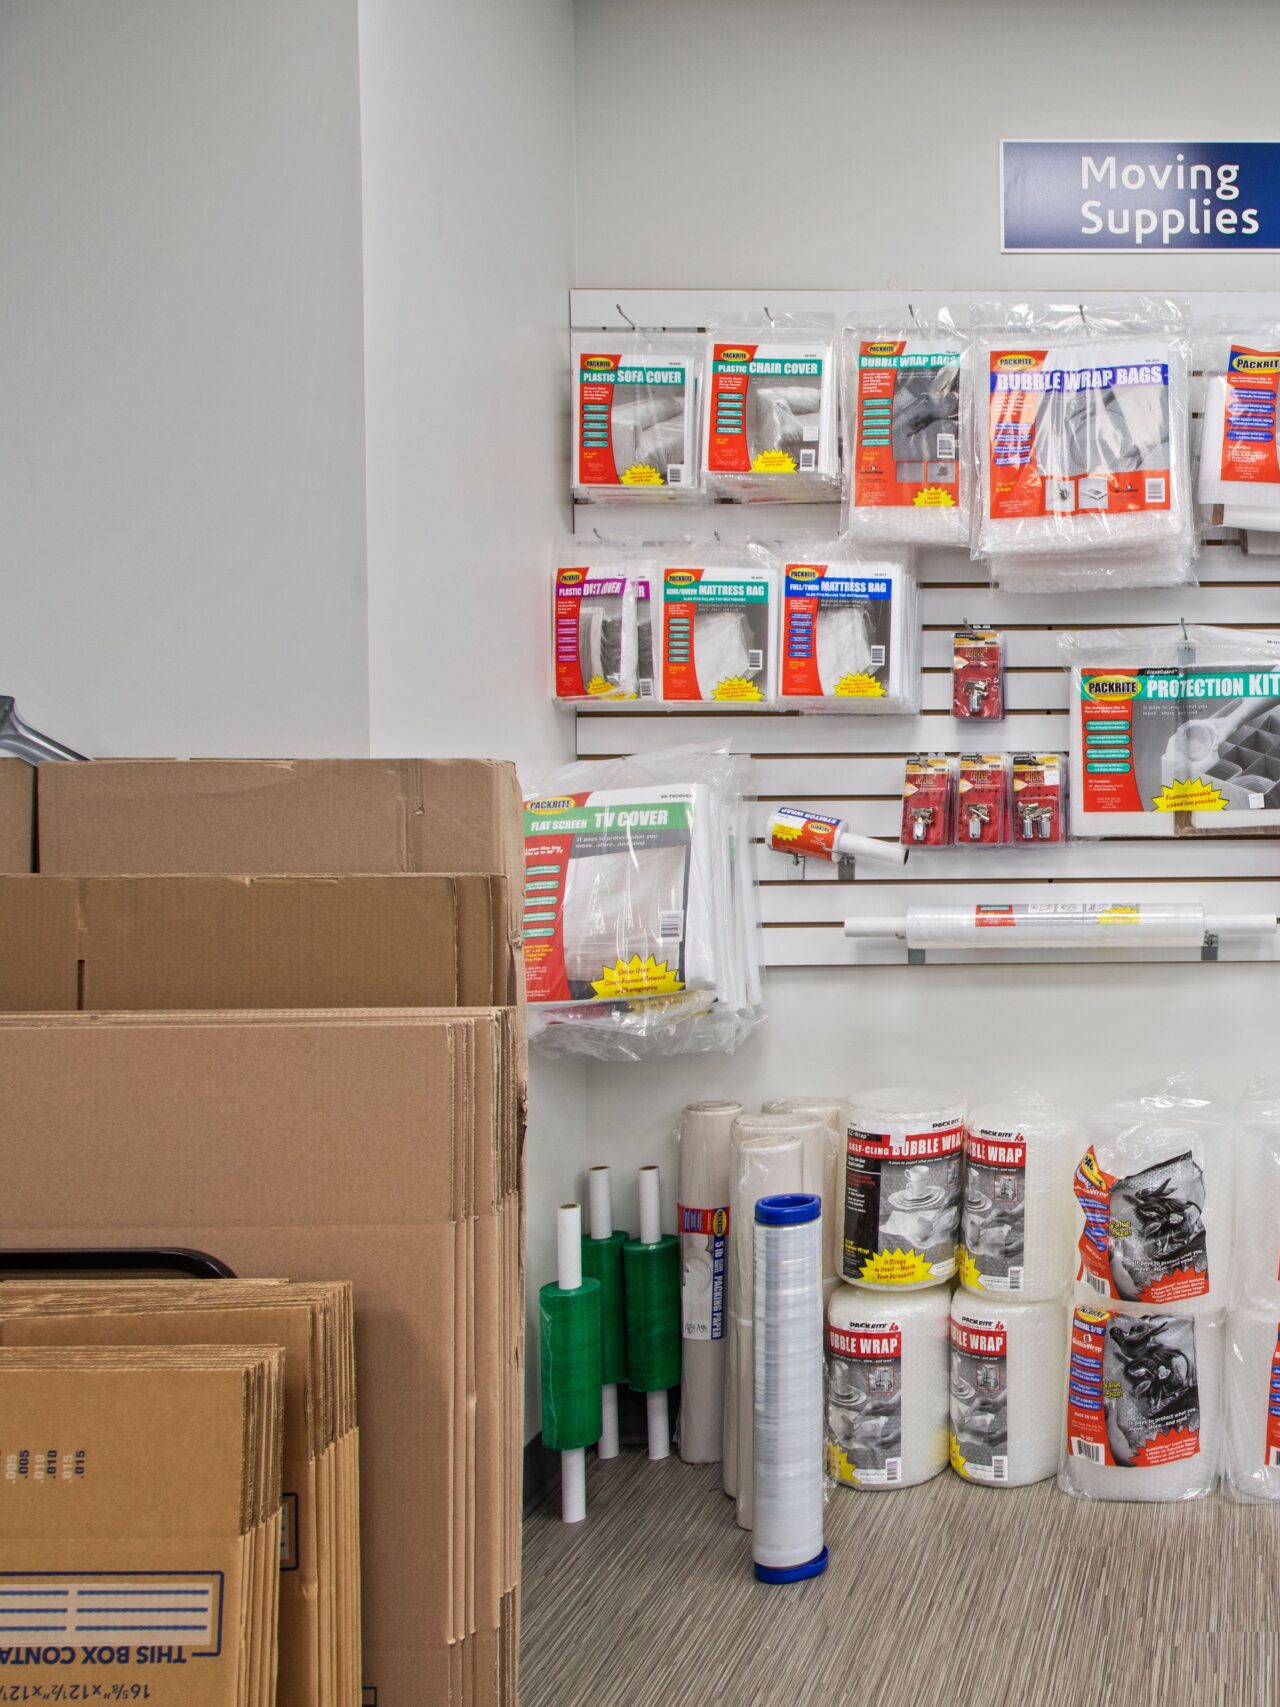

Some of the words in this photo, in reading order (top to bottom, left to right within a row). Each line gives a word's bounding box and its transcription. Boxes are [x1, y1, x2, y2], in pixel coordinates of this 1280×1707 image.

[1081, 154, 1240, 200] Moving
[1081, 198, 1259, 244] Supplies
[749, 362, 781, 373] CHAIR
[784, 363, 818, 374] COVER
[861, 357, 897, 366] BUBBLE
[900, 356, 928, 366] WRAP
[931, 356, 956, 365] BAGS
[584, 373, 615, 382] PLASTIC
[618, 371, 644, 382] SOFA
[646, 371, 681, 383] COVER
[996, 374, 1060, 390] BUBBLE
[1064, 370, 1112, 389] WRAP
[1117, 366, 1161, 385] BAGS
[559, 588, 581, 596] PLASTIC
[699, 585, 745, 595] MATTRESS
[746, 586, 764, 596] BAG
[821, 581, 866, 592] MATTRESS
[868, 582, 887, 592] BAG
[1089, 682, 1136, 693] PACKRITE
[1147, 677, 1248, 698] PROTECTION
[1249, 673, 1280, 696] KIT
[530, 800, 571, 809] PACKRITE
[530, 821, 552, 832] FLAT
[552, 820, 587, 831] SCREEN
[595, 813, 614, 828] TV
[617, 810, 668, 827] COVER
[848, 1143, 889, 1155] SELF-CLING
[942, 1131, 963, 1151] WRA
[988, 1146, 1022, 1163] WRAP
[715, 1248, 723, 1257] lb
[713, 1275, 723, 1311] PACKING
[712, 1312, 722, 1338] PAPER
[860, 1339, 898, 1354] WRAP
[969, 1334, 1003, 1351] WRAP
[5, 1455, 17, 1484] .005
[19, 1450, 29, 1479] .005
[34, 1455, 45, 1484] .010
[47, 1450, 57, 1479] .010
[75, 1450, 85, 1479] .015
[81, 1646, 130, 1664] BOX
[136, 1646, 187, 1664] THIS
